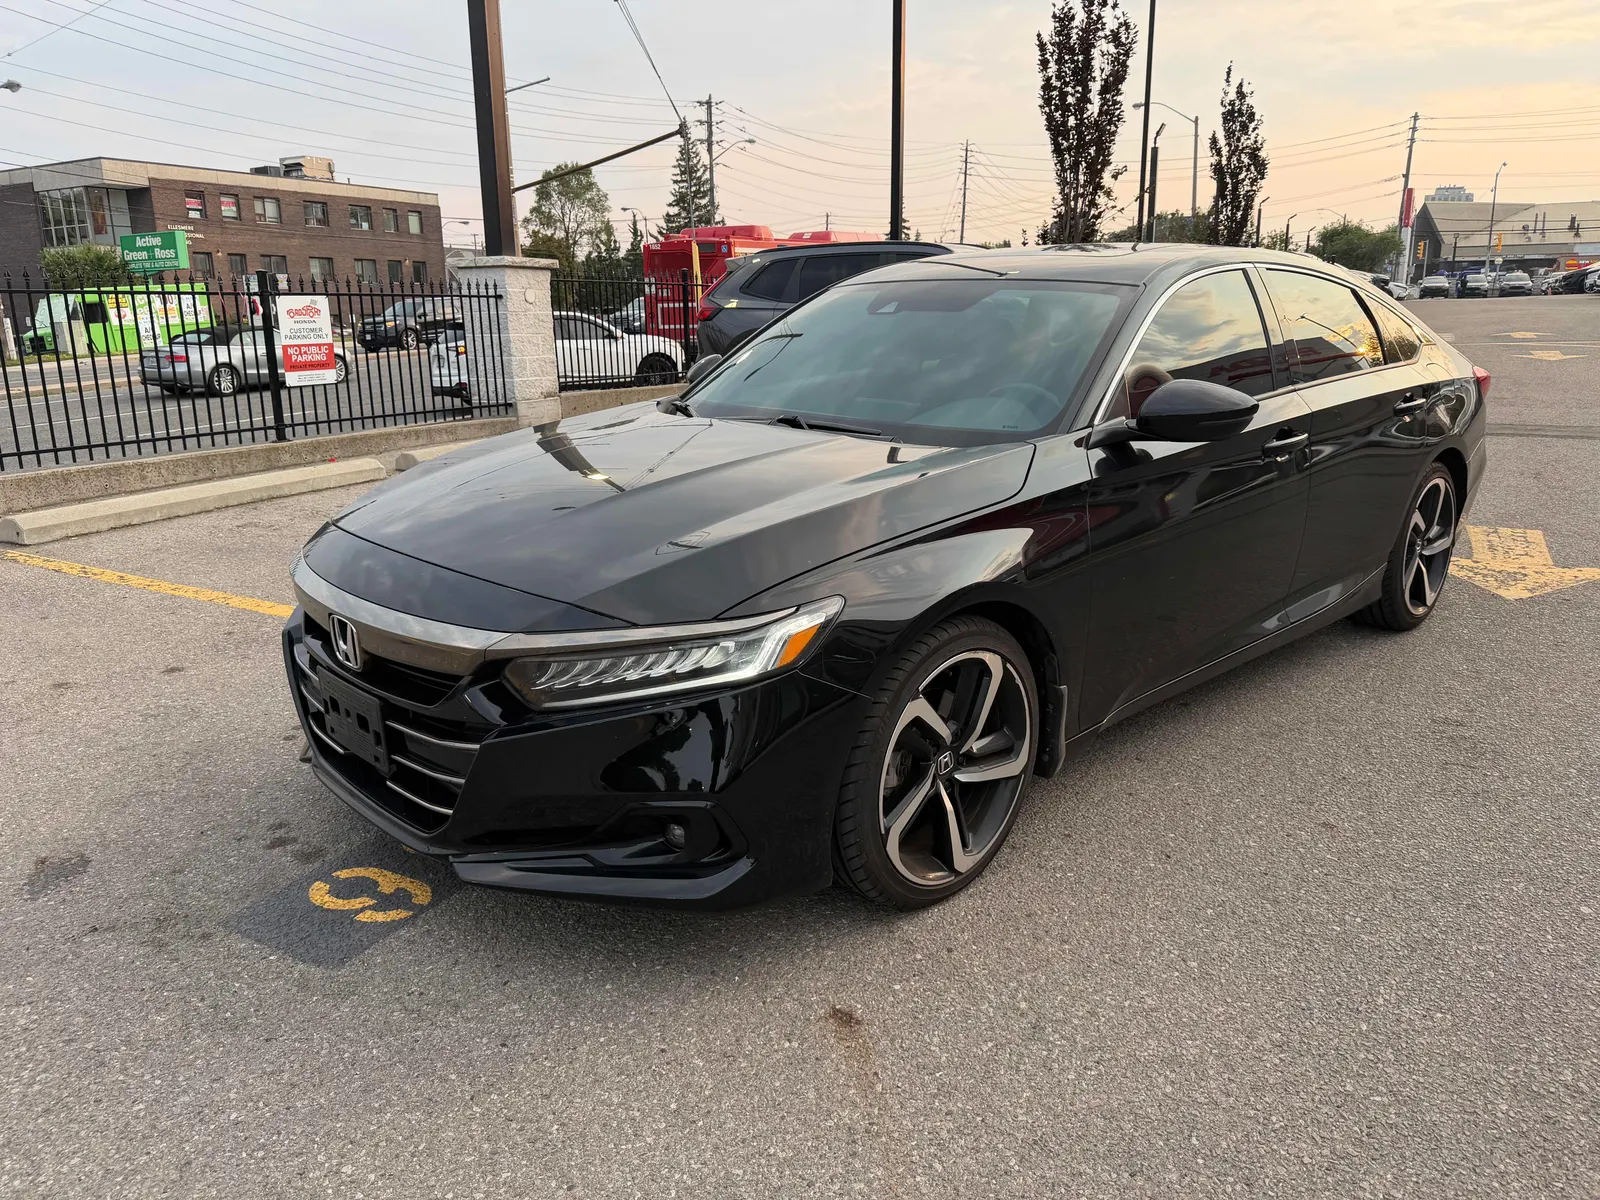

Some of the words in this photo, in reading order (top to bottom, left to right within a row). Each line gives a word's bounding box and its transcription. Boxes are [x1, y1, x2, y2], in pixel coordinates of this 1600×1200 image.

[135, 235, 162, 248] Active
[123, 249, 148, 261] Green
[154, 248, 176, 259] Ross
[287, 346, 300, 355] NO
[301, 345, 329, 354] PUBLIC
[292, 353, 327, 362] PARKING
